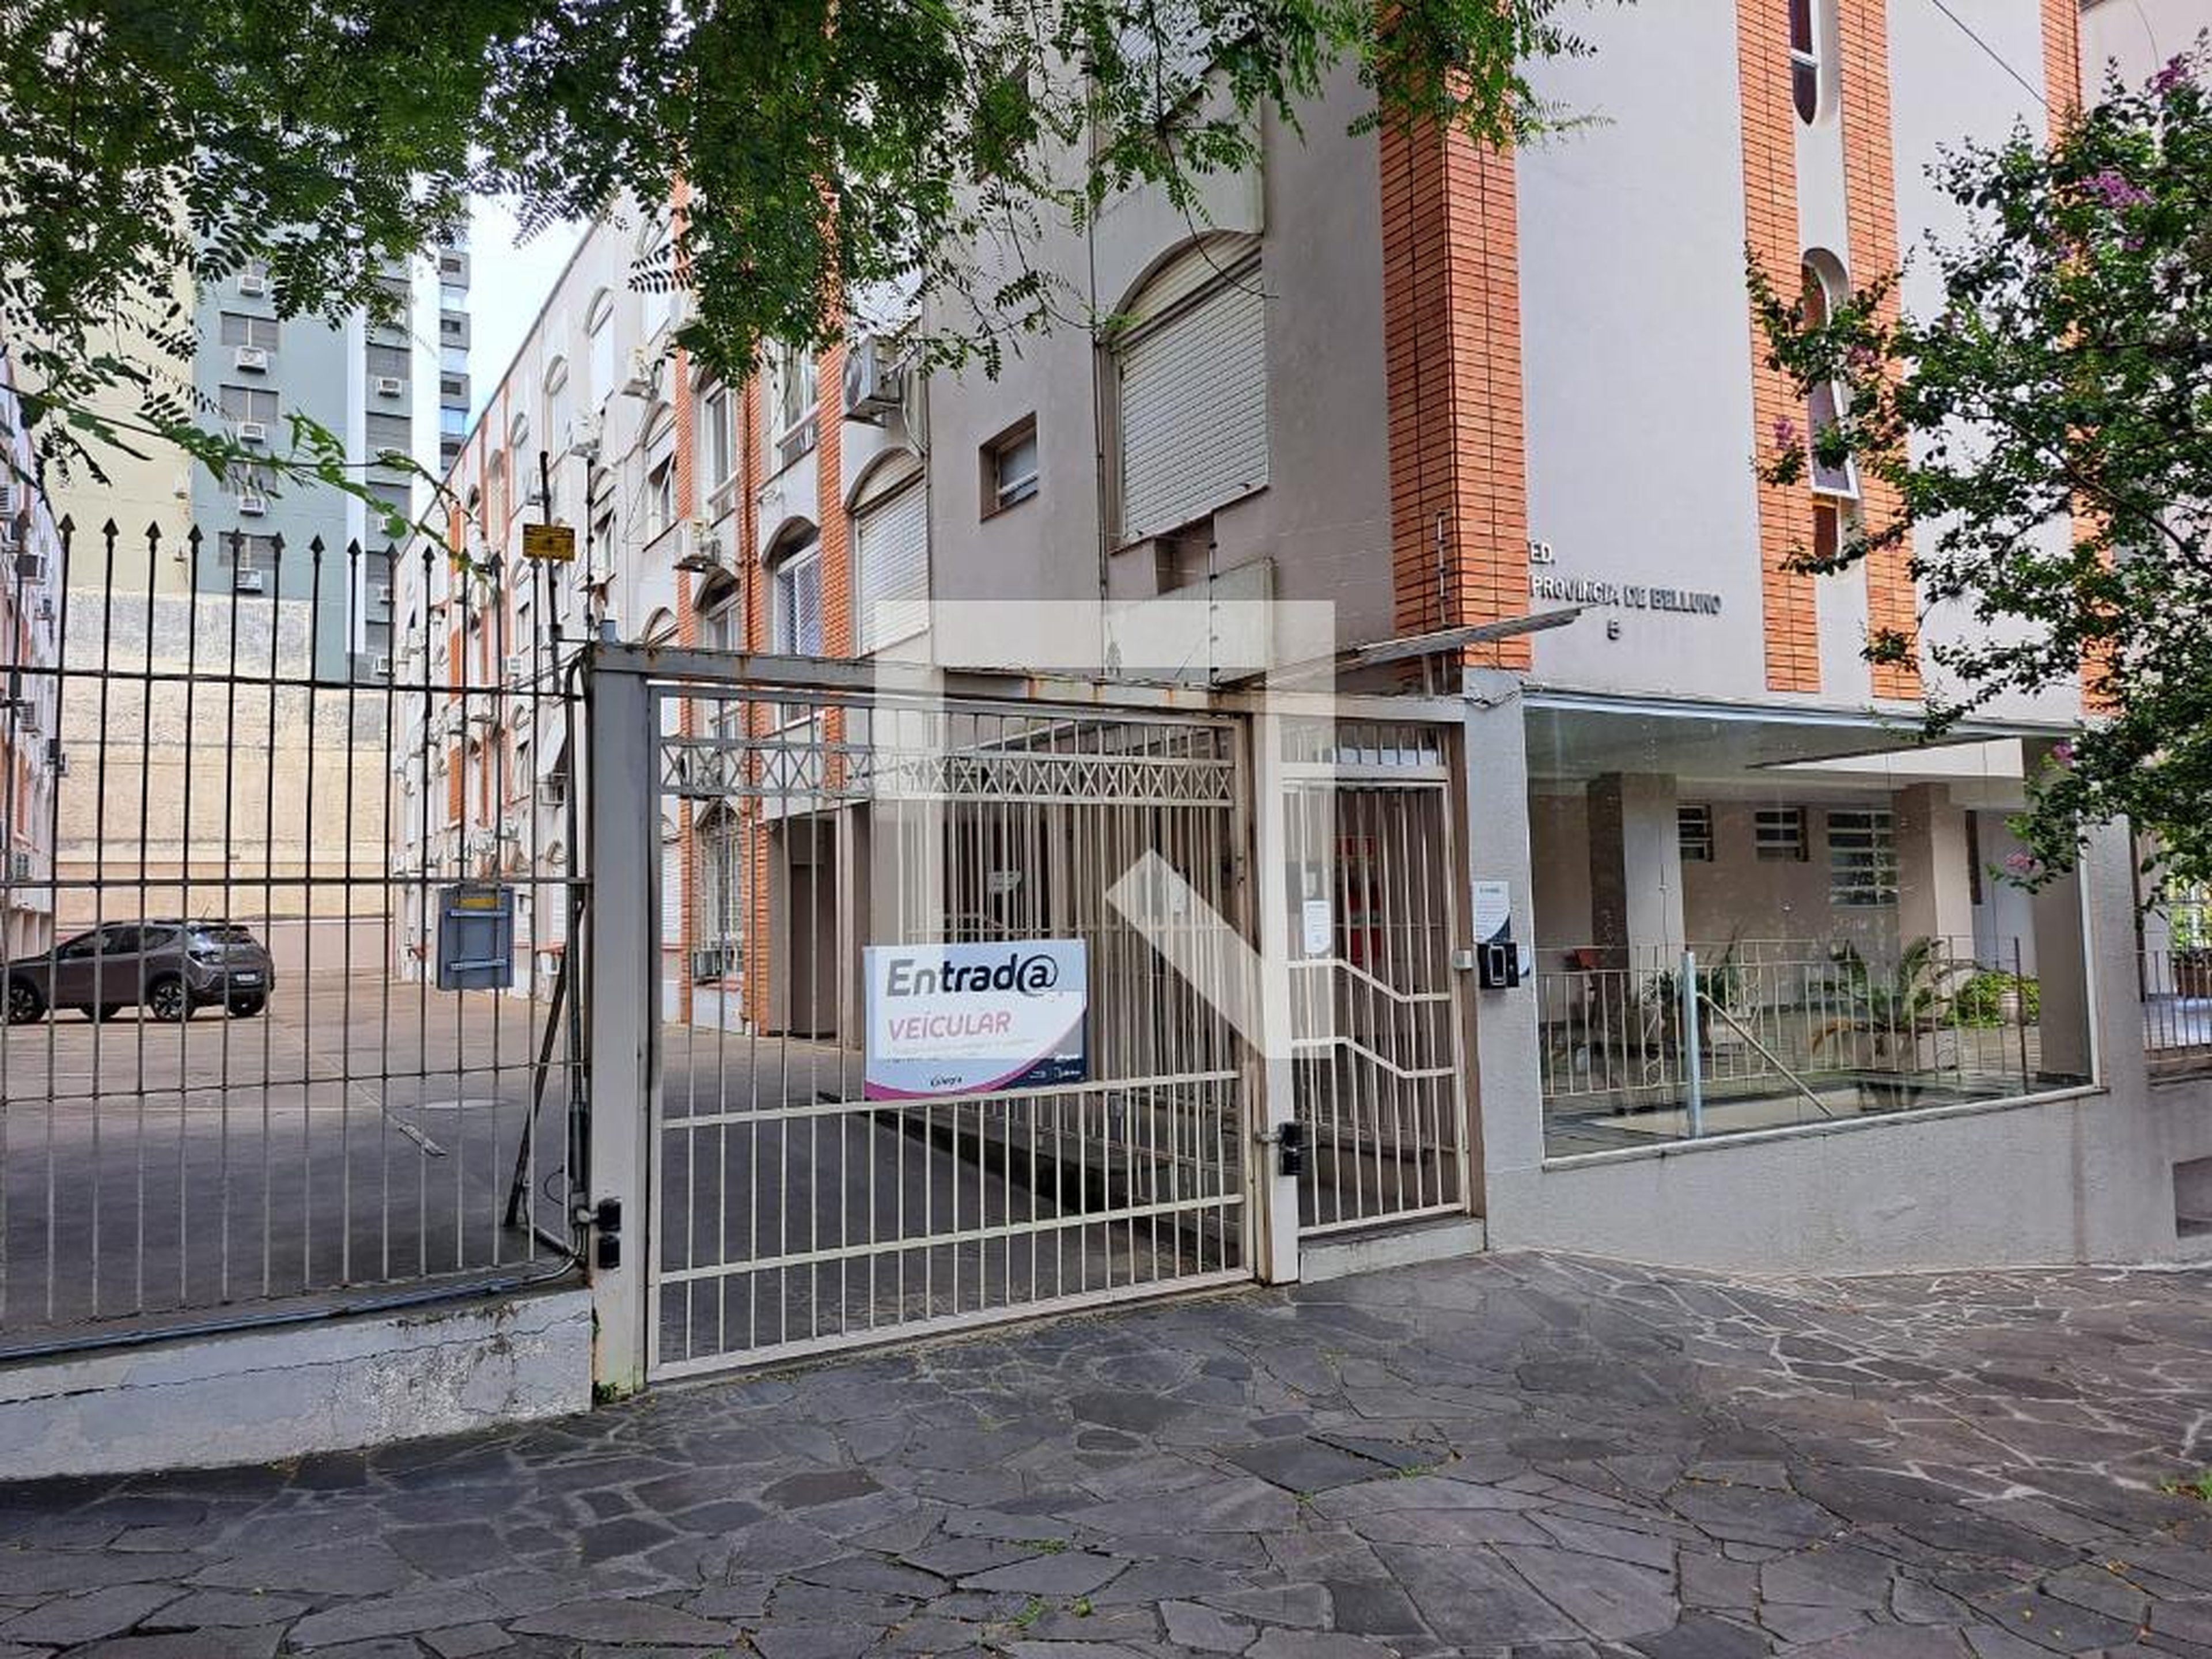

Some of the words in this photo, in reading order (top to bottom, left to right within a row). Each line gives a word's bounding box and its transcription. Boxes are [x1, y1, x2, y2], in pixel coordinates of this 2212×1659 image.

[1528, 540, 1555, 565] ED.
[1624, 585, 1646, 609] DE
[888, 1010, 1012, 1041] VEÍCULAR
